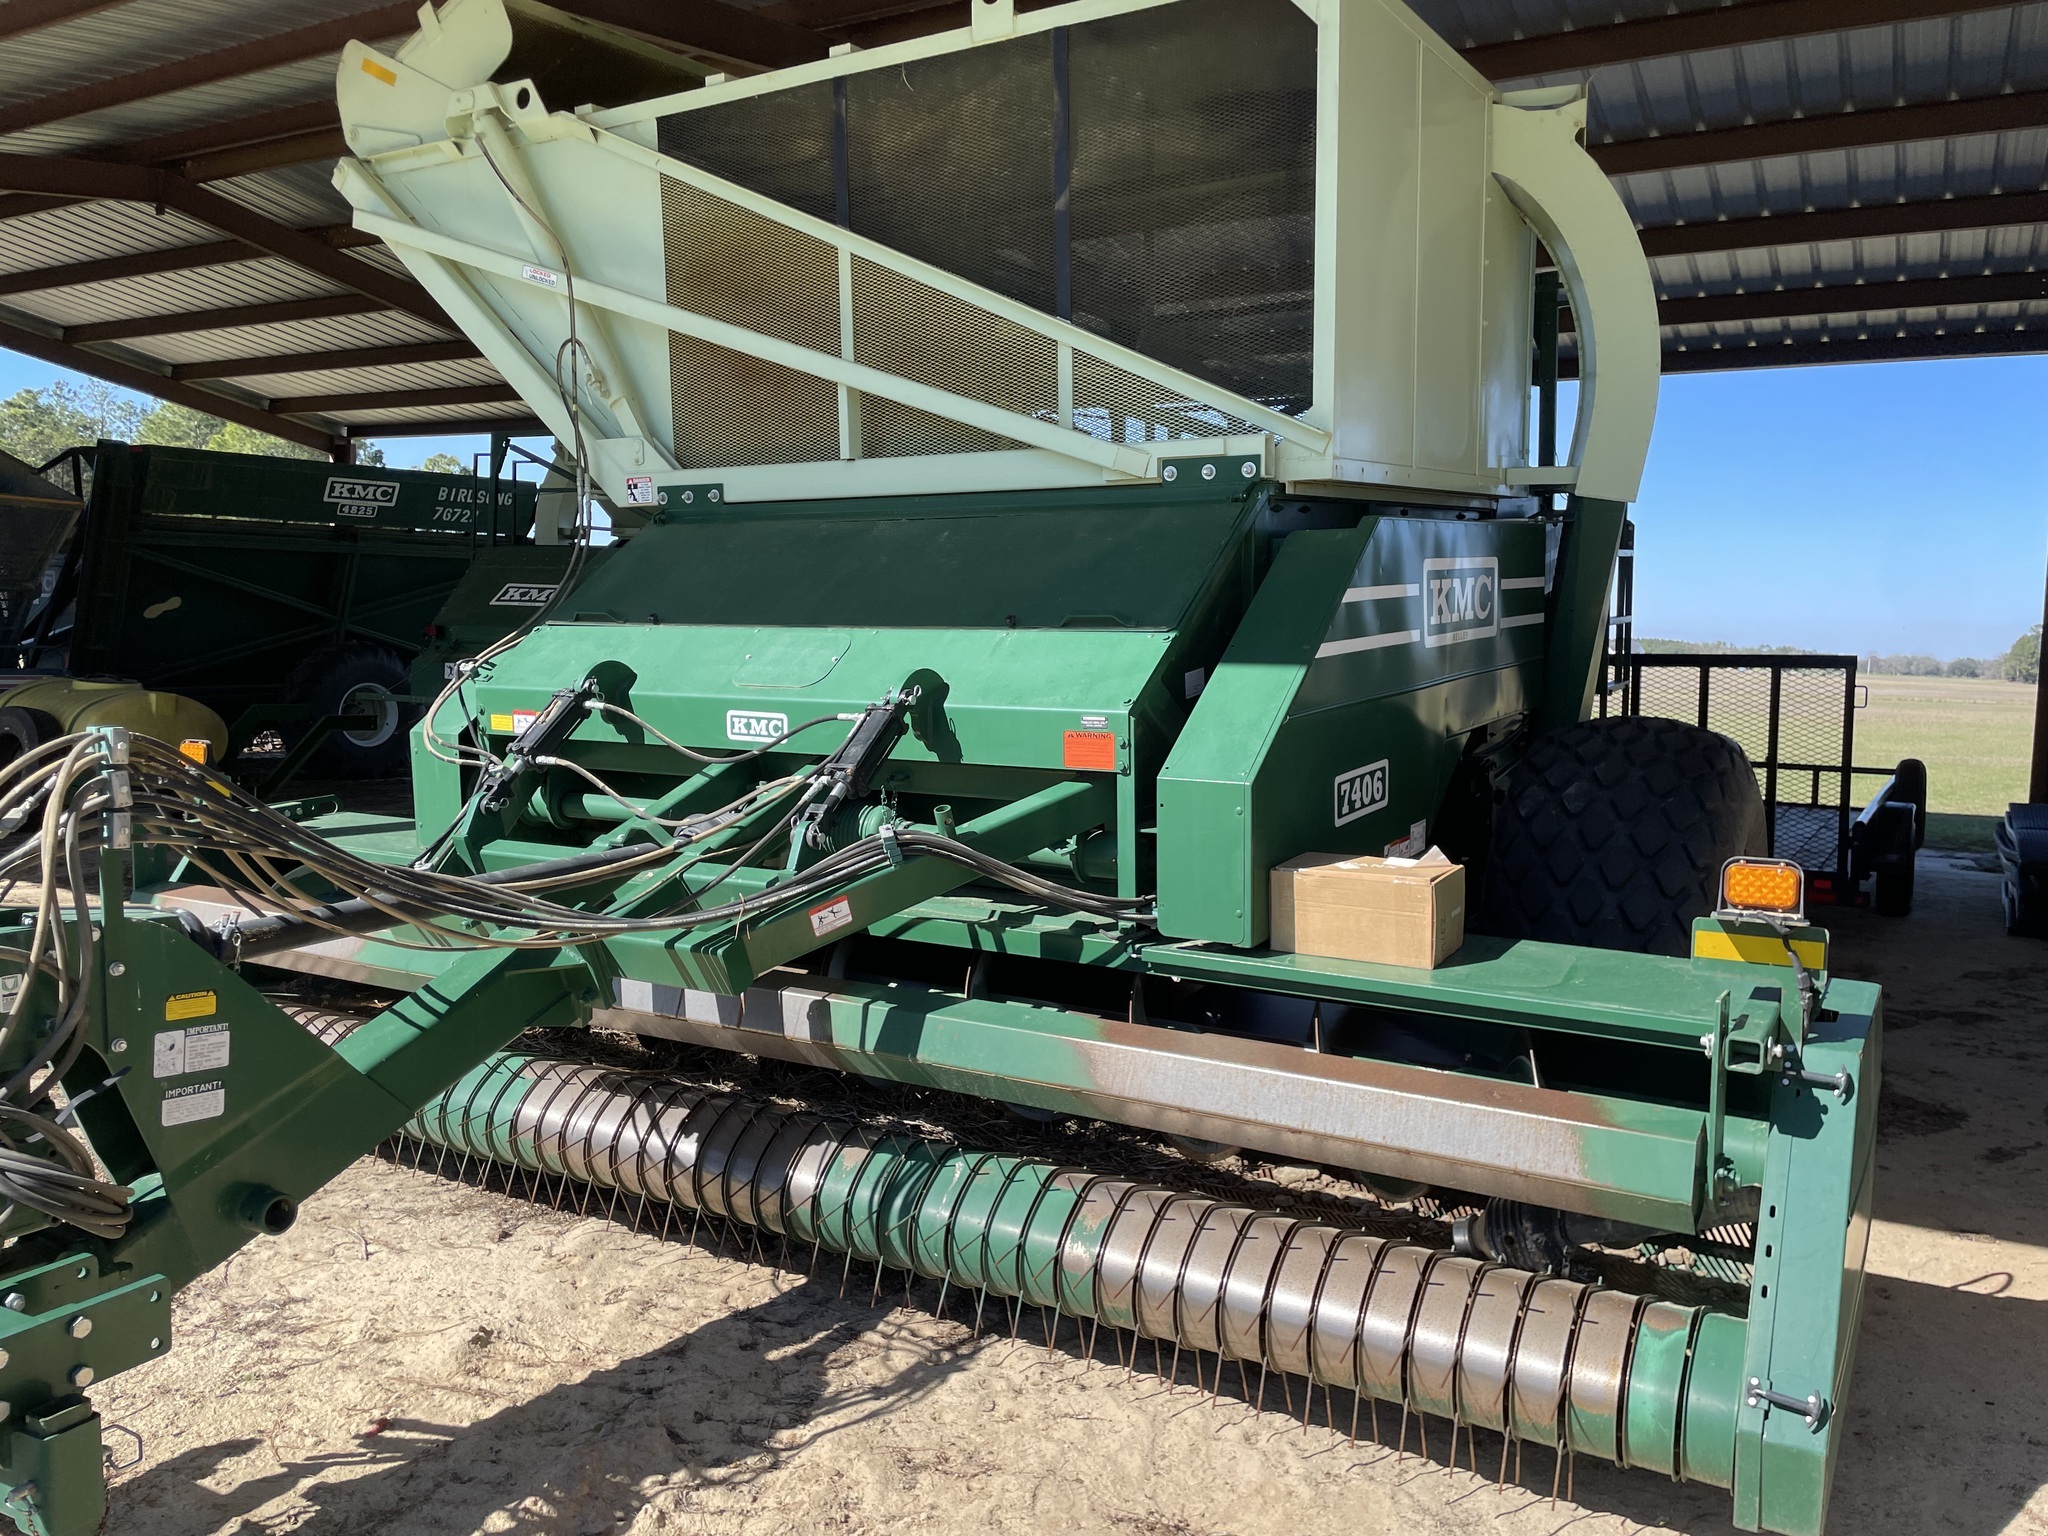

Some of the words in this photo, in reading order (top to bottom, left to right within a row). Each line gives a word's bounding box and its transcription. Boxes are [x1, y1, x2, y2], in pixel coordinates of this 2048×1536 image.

[529, 273, 556, 286] UNLOCKED
[530, 268, 552, 279] LOCKED
[331, 483, 394, 501] KMC
[342, 505, 374, 515] 4825
[432, 506, 479, 523] 7672
[500, 587, 555, 601] KM
[1430, 574, 1492, 625] KMC
[1452, 632, 1469, 642] KELLEY
[732, 717, 783, 738] KMC
[1340, 770, 1383, 815] 7406
[175, 991, 208, 1000] CAUTION
[186, 1022, 229, 1036] IMPORTANT!
[165, 1081, 222, 1099] IMPORTANT!
